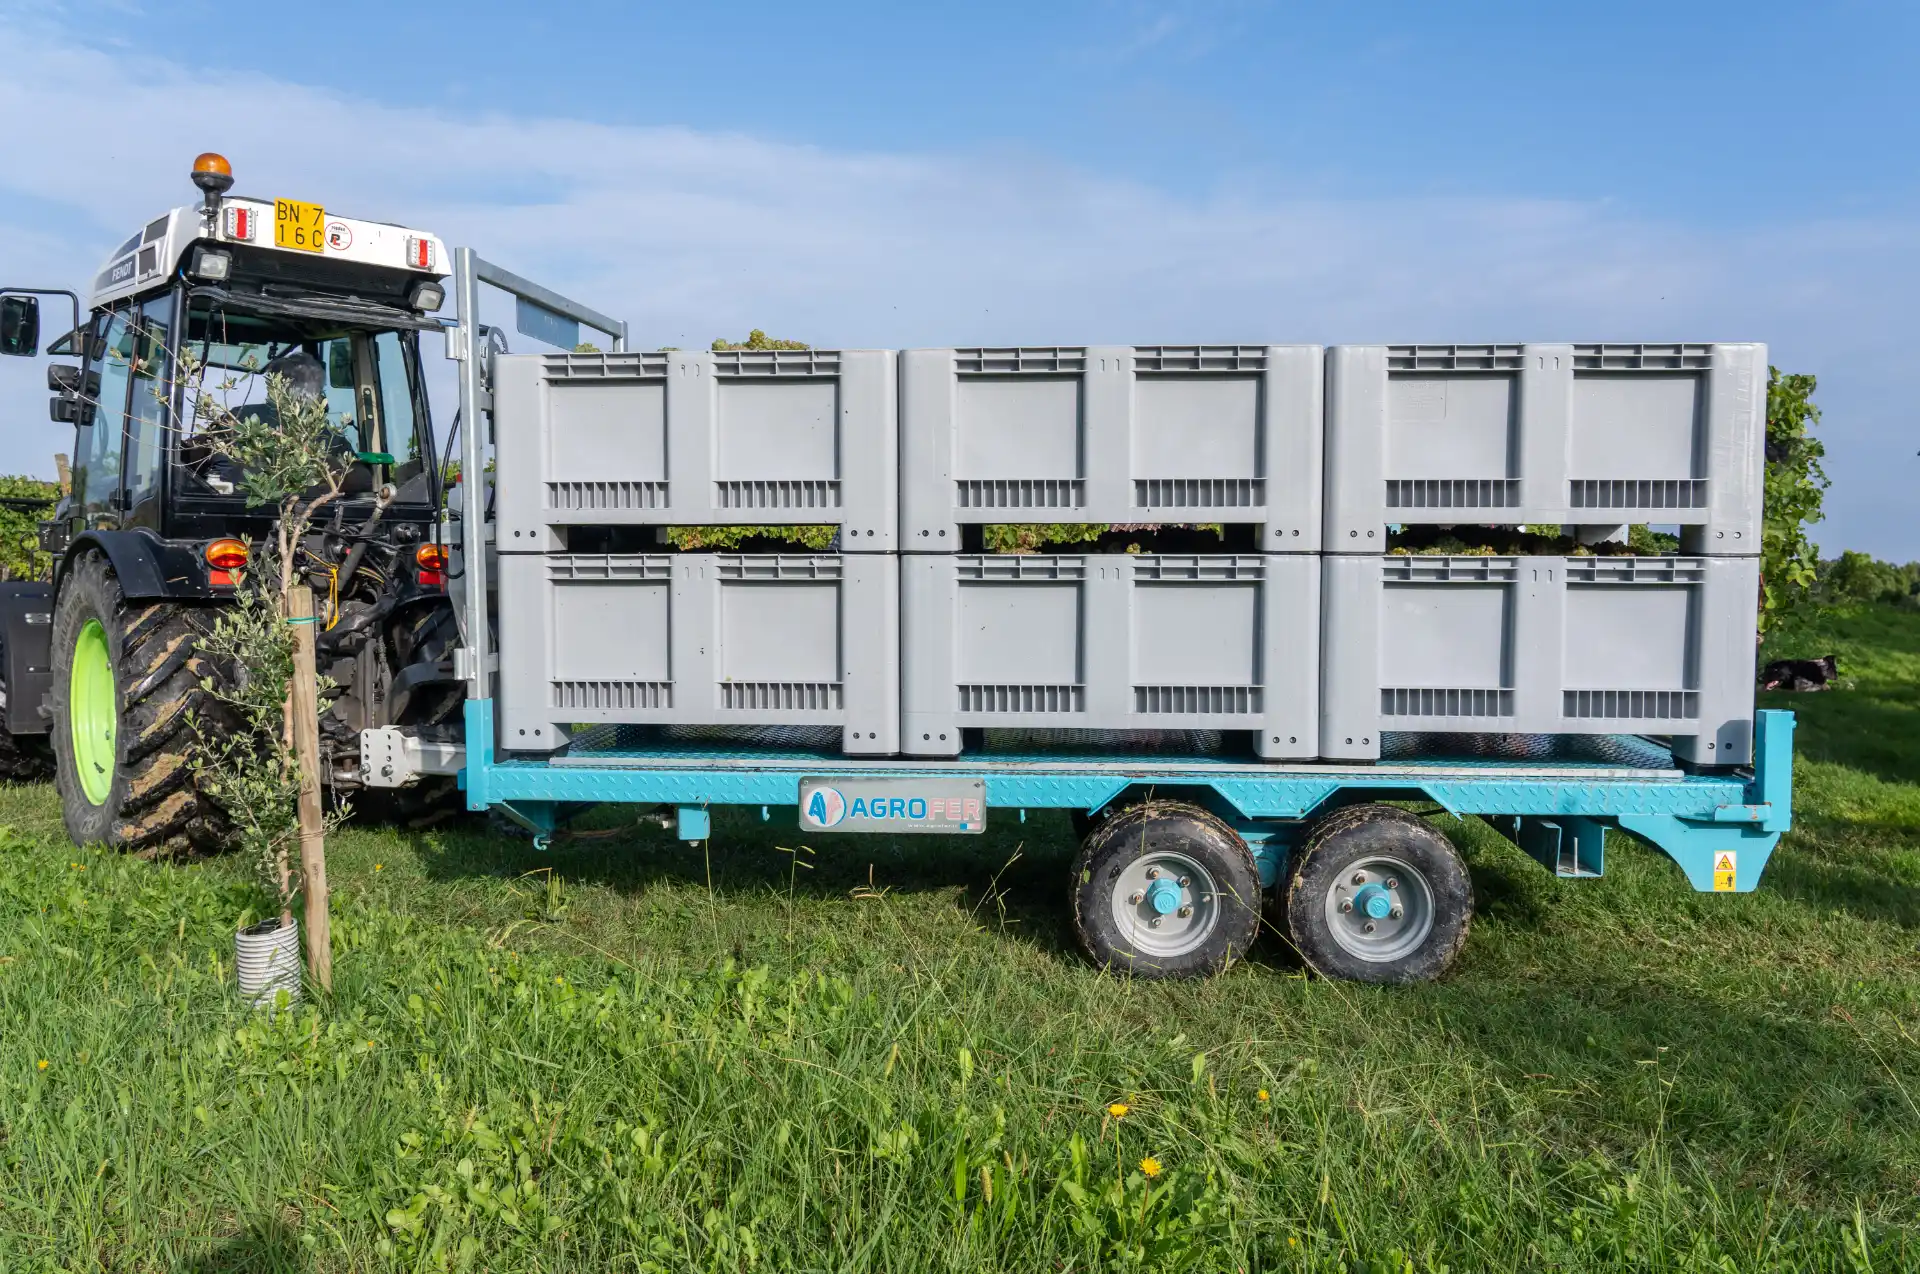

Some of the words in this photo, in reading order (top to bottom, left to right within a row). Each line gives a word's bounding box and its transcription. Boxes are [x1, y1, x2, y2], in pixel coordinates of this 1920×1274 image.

[277, 200, 300, 223] BN
[313, 207, 323, 226] 7
[111, 261, 133, 282] FENDT
[850, 797, 981, 821] AGROFER
